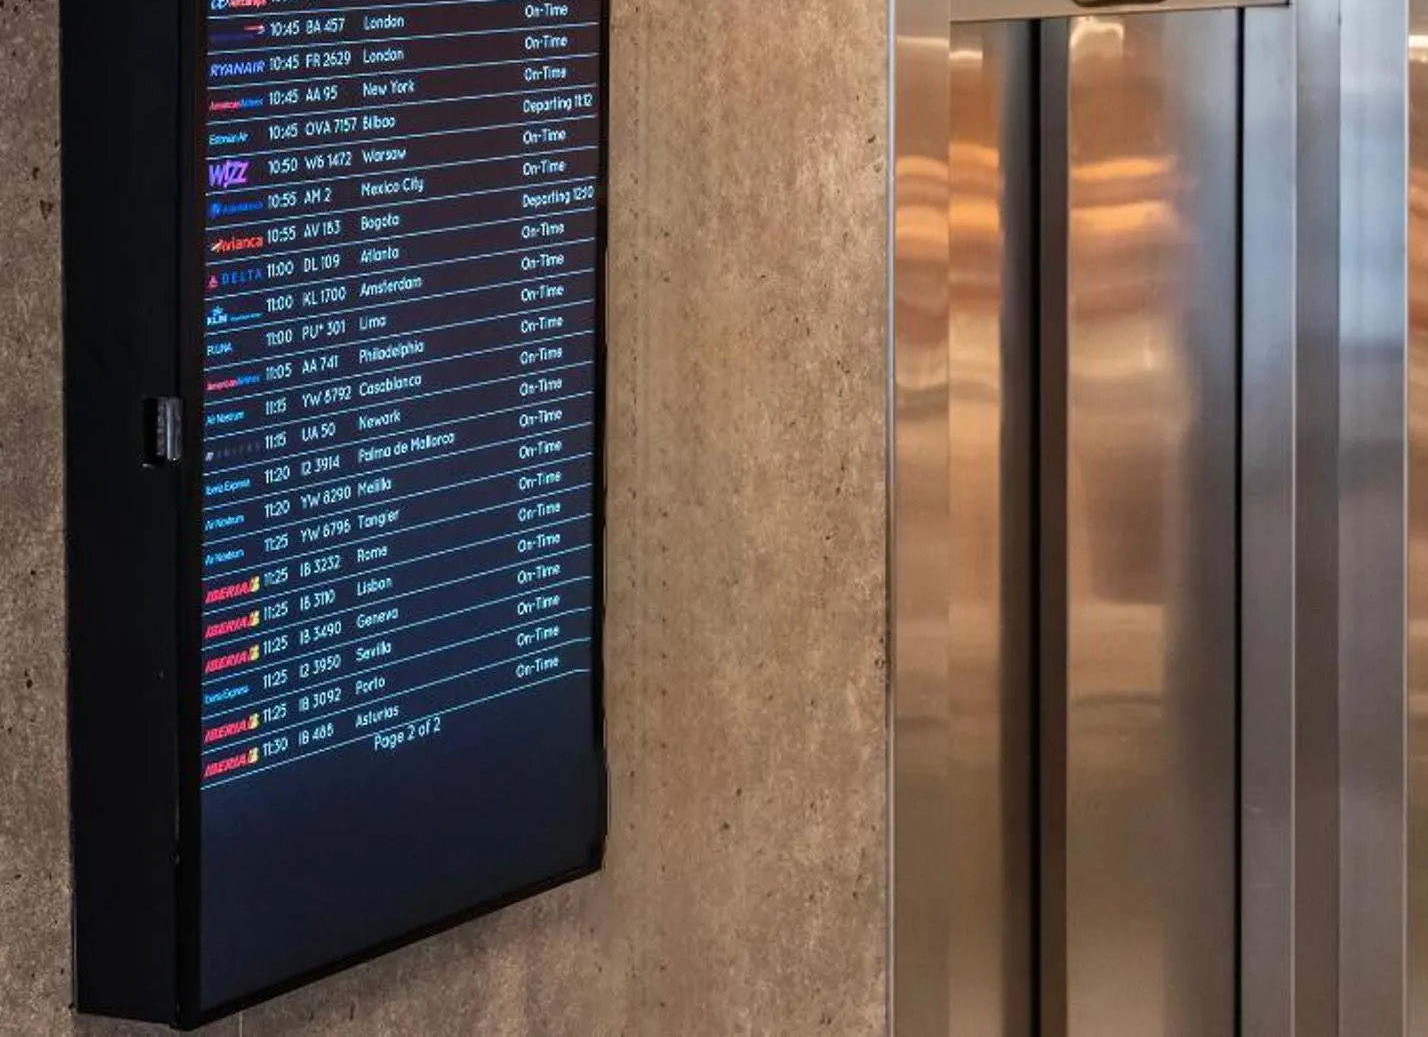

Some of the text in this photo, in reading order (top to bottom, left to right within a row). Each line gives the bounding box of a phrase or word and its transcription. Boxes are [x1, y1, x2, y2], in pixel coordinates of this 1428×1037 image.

[364, 14, 404, 30] London
[525, 3, 568, 18] On-Time
[363, 47, 404, 63] London
[525, 34, 567, 50] On-Time
[306, 87, 321, 101] AA
[323, 85, 337, 101] 95
[363, 83, 387, 97] New
[390, 79, 414, 94] York
[524, 66, 566, 82] On-Time
[363, 115, 395, 130] Bilbao
[523, 96, 572, 114] Departing
[362, 149, 406, 163] Warsaw
[523, 128, 566, 145] On-Time
[361, 180, 400, 196] Mexico
[401, 176, 424, 193] City
[523, 159, 566, 176] On-Time
[361, 213, 399, 231] Bogota
[523, 190, 570, 208] Departing
[360, 246, 399, 263] Atlanta
[521, 222, 564, 239] On-Time
[360, 277, 422, 297] Amsterdam
[521, 254, 564, 270] On-Time
[359, 316, 386, 330] Lima
[521, 285, 564, 302] On-Time
[302, 358, 317, 374] AA
[359, 340, 424, 363] Philadelphia
[521, 317, 563, 333] On-Time
[359, 375, 421, 396] Casablanca
[520, 347, 562, 365] On-Time
[359, 409, 400, 430] Newark
[520, 378, 562, 396] On-Time
[358, 446, 391, 462] Palma
[394, 442, 408, 455] de
[411, 433, 454, 451] Mallorca
[519, 410, 562, 427] On-Time
[358, 477, 392, 496] Melilla
[519, 441, 562, 459] On-Time
[358, 510, 399, 529] Tangier
[519, 471, 561, 490] On-Time
[357, 546, 387, 563] Rome
[518, 502, 560, 522] On-Time
[357, 578, 392, 596] Lisbon
[518, 534, 560, 552] On-Time
[356, 608, 398, 628] Geneva
[518, 564, 560, 584] On-Time
[356, 641, 391, 662] Sevilla
[517, 595, 560, 615] On-Time
[355, 676, 385, 695] Porto
[517, 626, 559, 647] On-Time
[356, 705, 399, 728] Asturias
[516, 657, 559, 678] On-Time
[374, 717, 441, 751] Page 2 of 2
